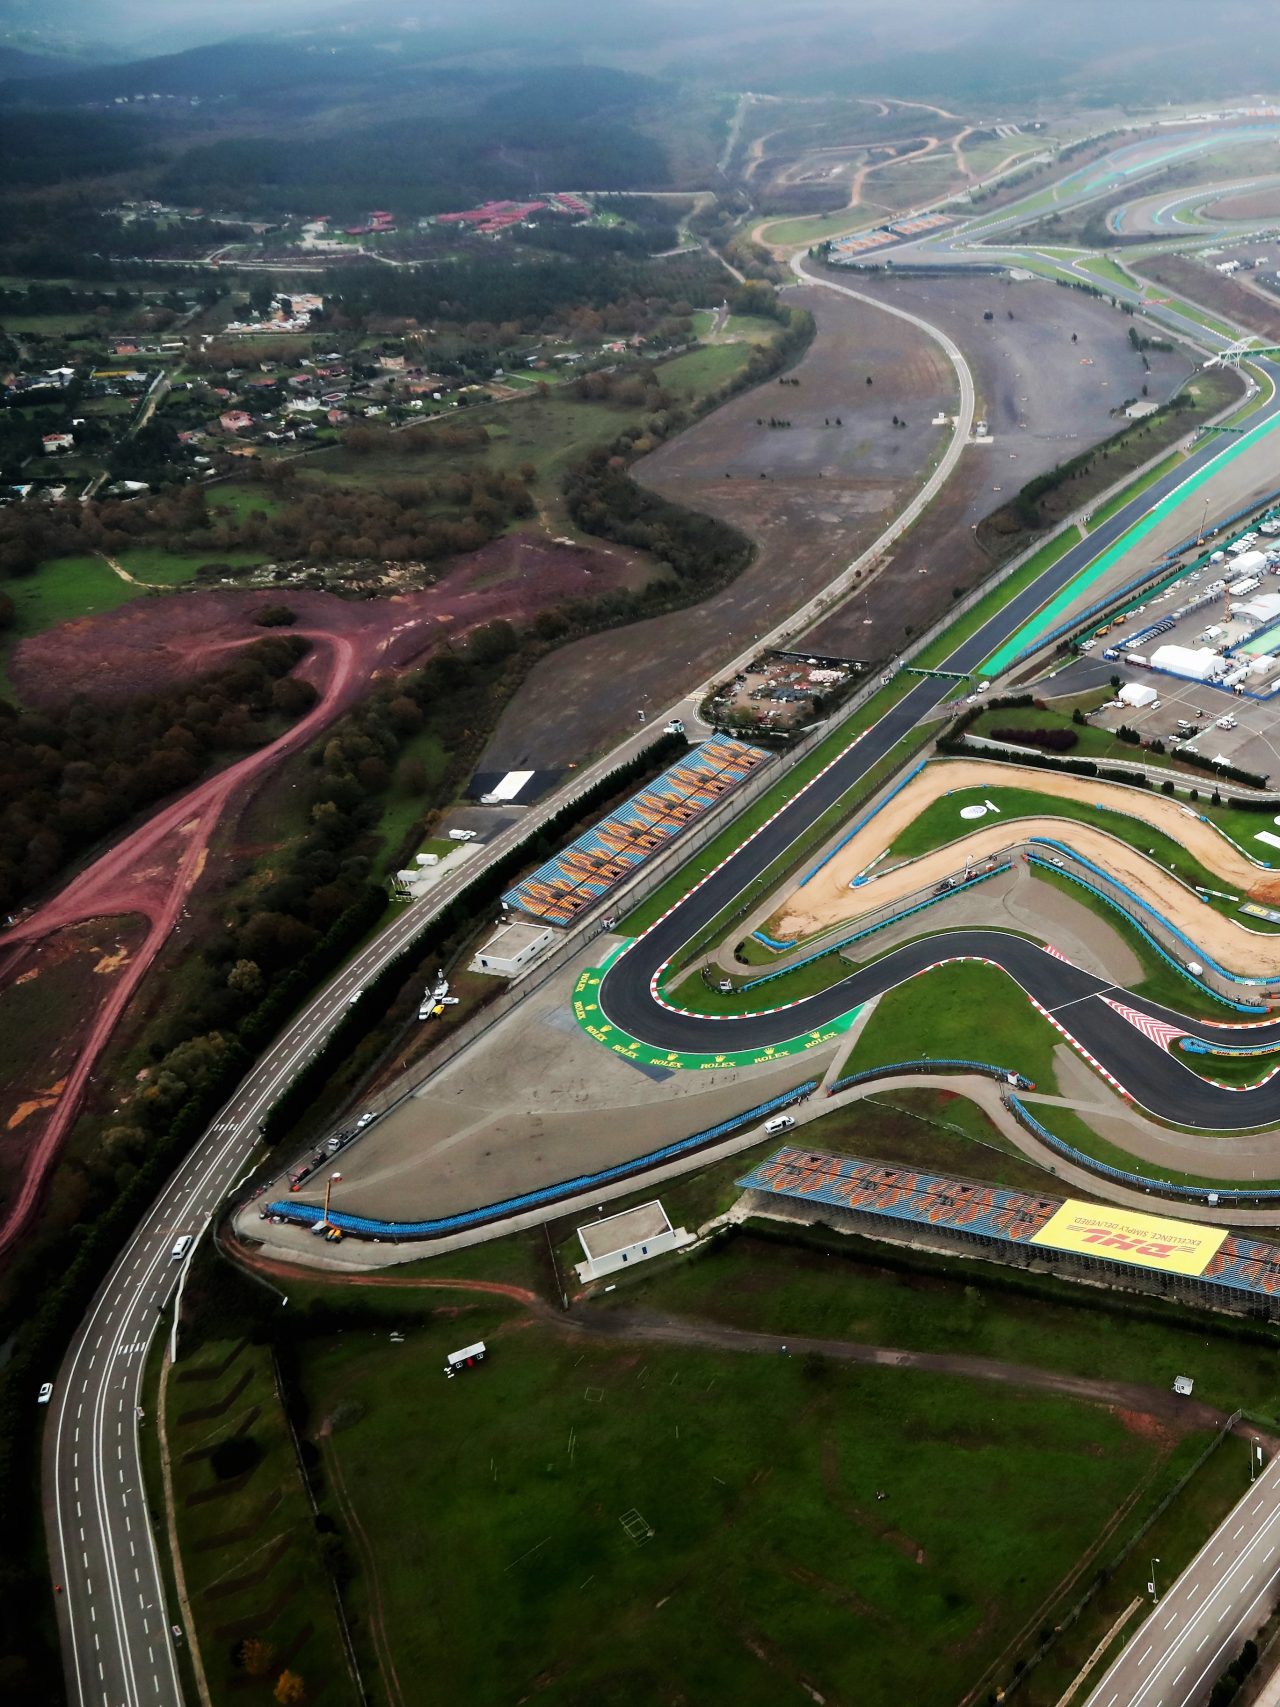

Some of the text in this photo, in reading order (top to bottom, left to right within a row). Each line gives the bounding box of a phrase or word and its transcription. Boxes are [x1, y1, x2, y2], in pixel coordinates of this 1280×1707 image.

[585, 1025, 608, 1042] ROLEX
[804, 1031, 838, 1049] ROLEX
[612, 1044, 640, 1059] ROLEX
[754, 1050, 790, 1063] ROLEX
[650, 1058, 684, 1068] ROLEX
[700, 1061, 736, 1069] ROLEX
[1119, 1225, 1148, 1238] SIMPLY
[1081, 1228, 1178, 1259] DHL
